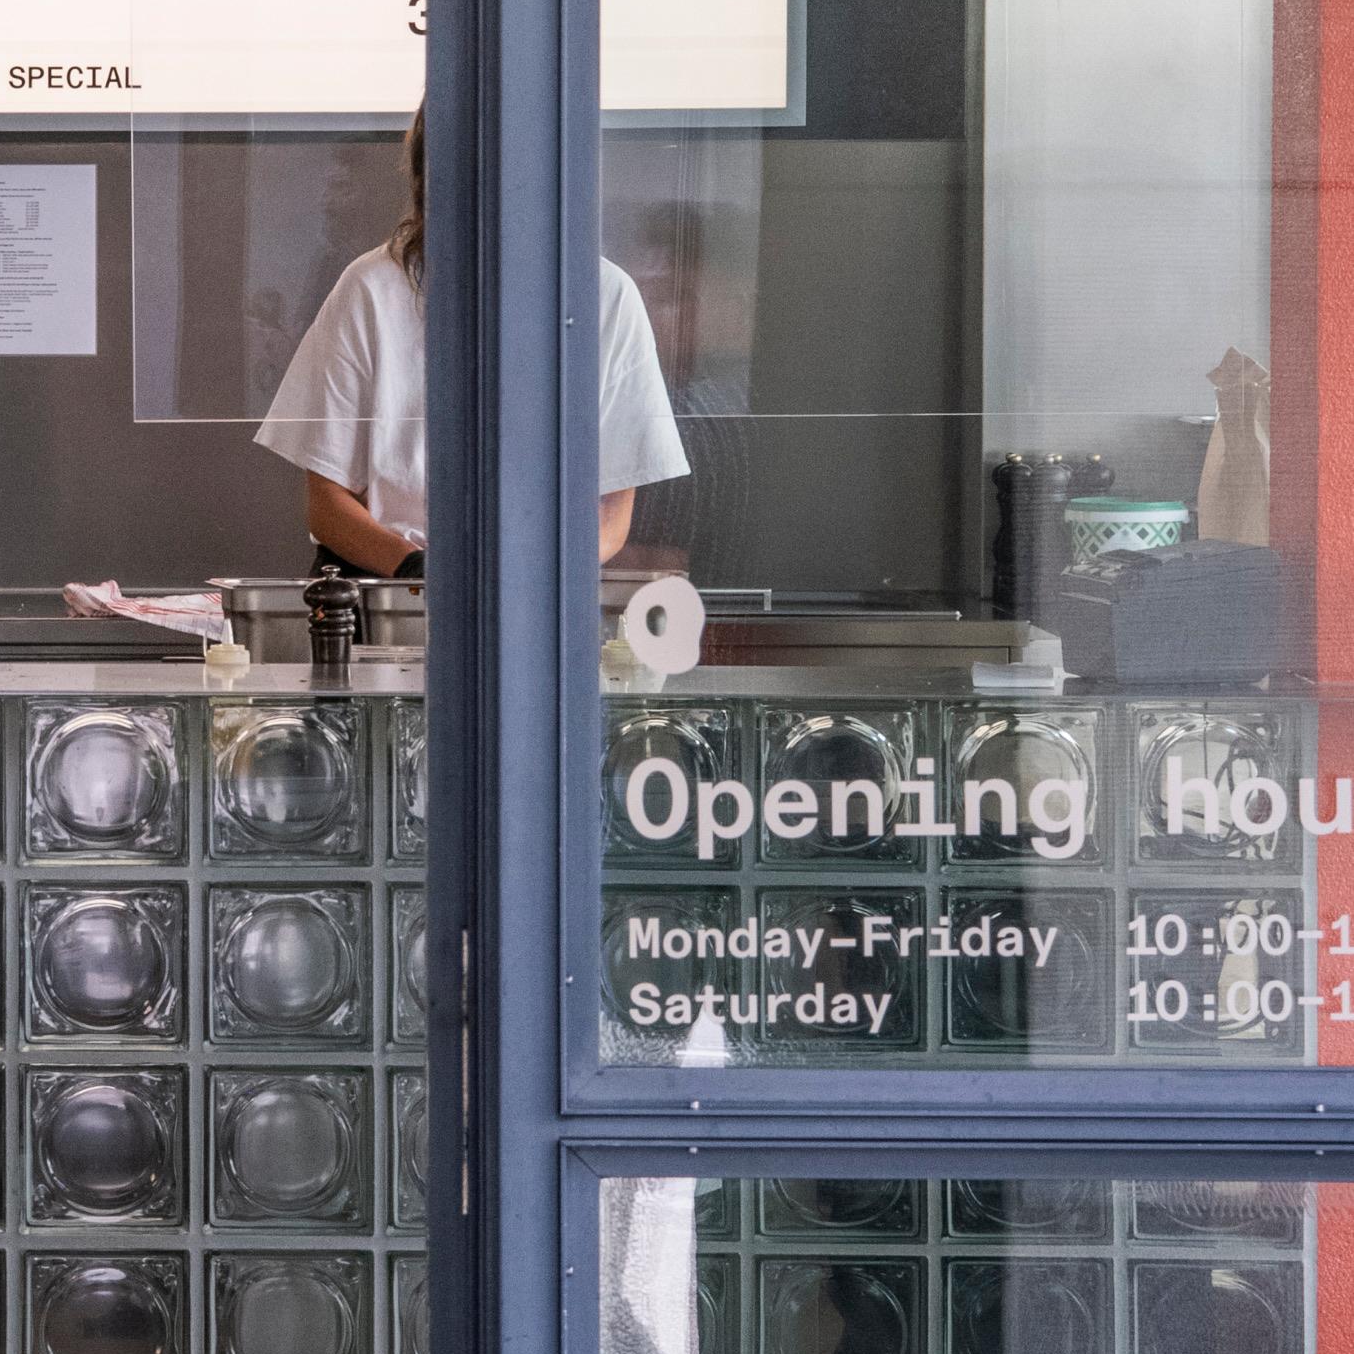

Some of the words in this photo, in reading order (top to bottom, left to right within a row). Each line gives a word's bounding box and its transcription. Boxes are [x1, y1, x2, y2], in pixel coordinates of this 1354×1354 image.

[8, 66, 142, 89] SPECIAL
[626, 756, 1086, 860] Opening
[1167, 755, 1353, 836] hou
[629, 982, 892, 1035] Saturday
